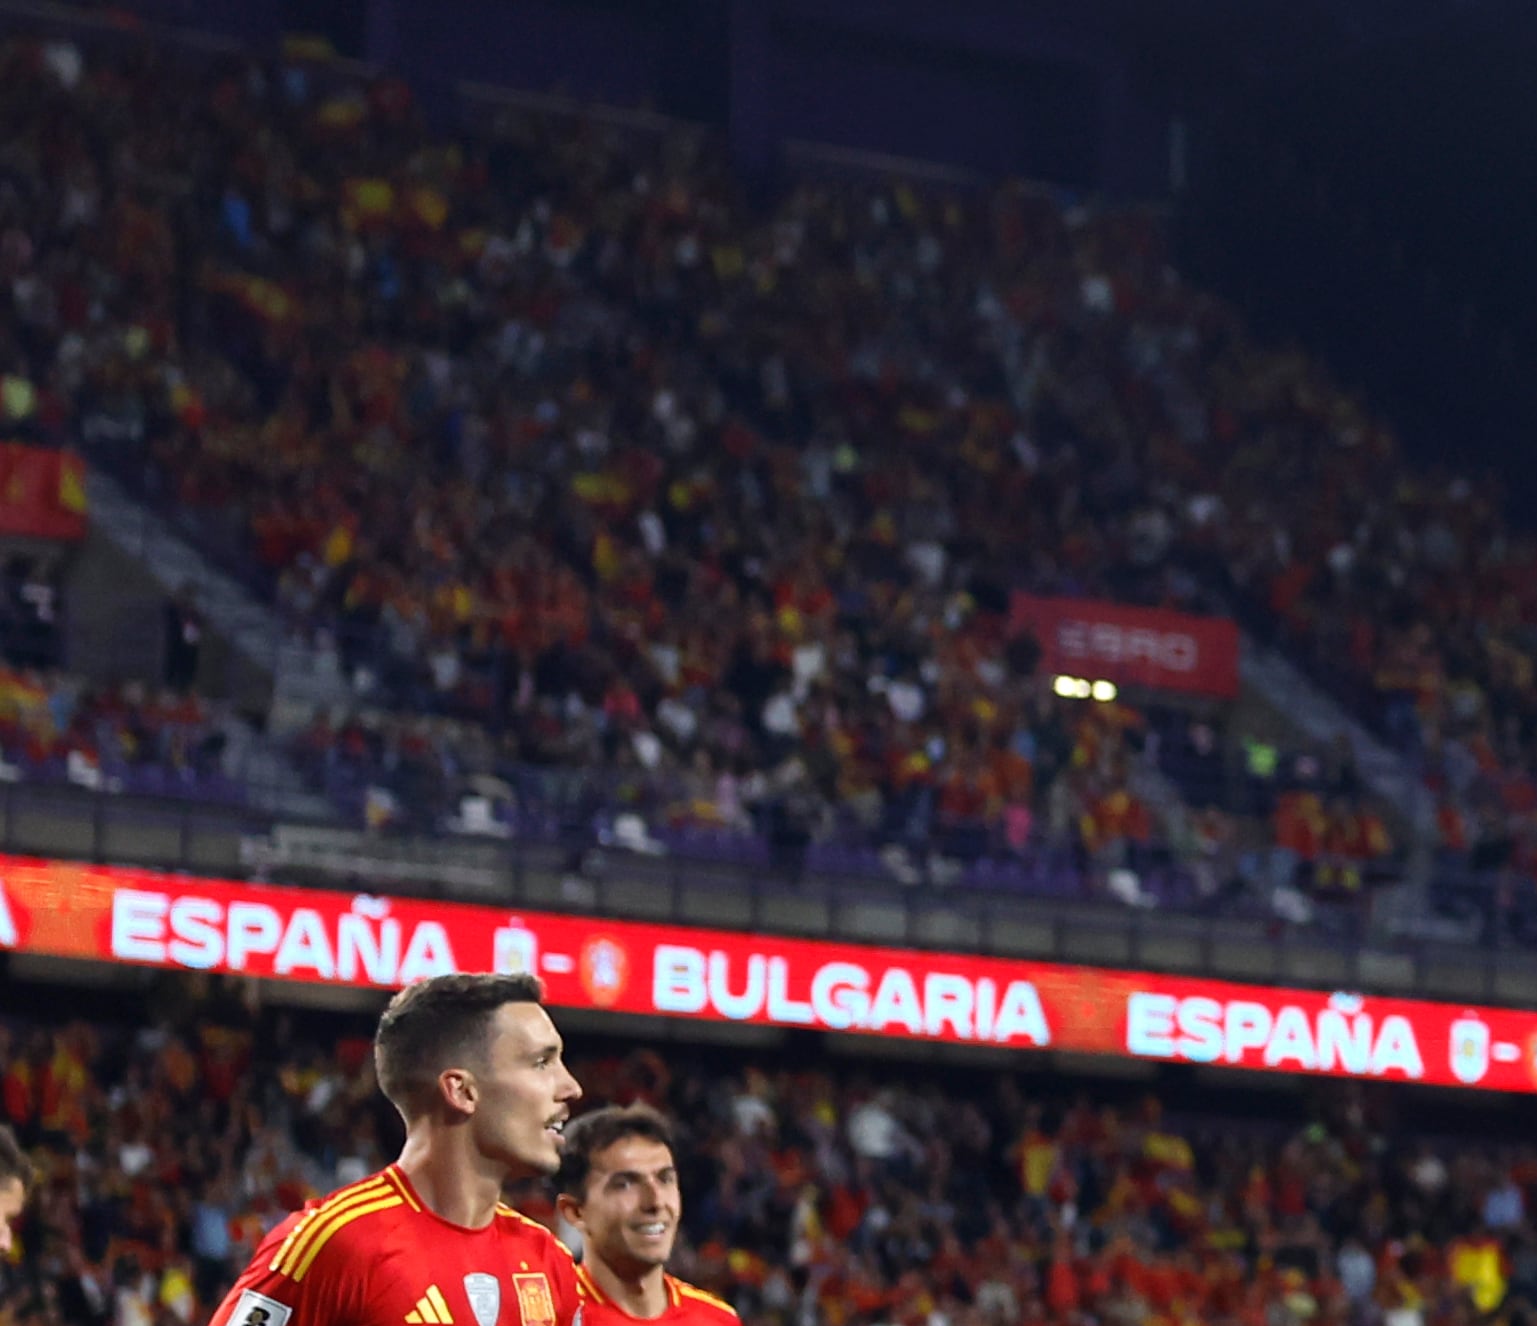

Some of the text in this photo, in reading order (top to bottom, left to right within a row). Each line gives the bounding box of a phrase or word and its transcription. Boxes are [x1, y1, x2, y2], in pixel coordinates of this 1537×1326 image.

[111, 887, 458, 986] ESPAÑA
[652, 945, 1049, 1046] BULGARIA
[1126, 991, 1424, 1079] ESPAÑA
